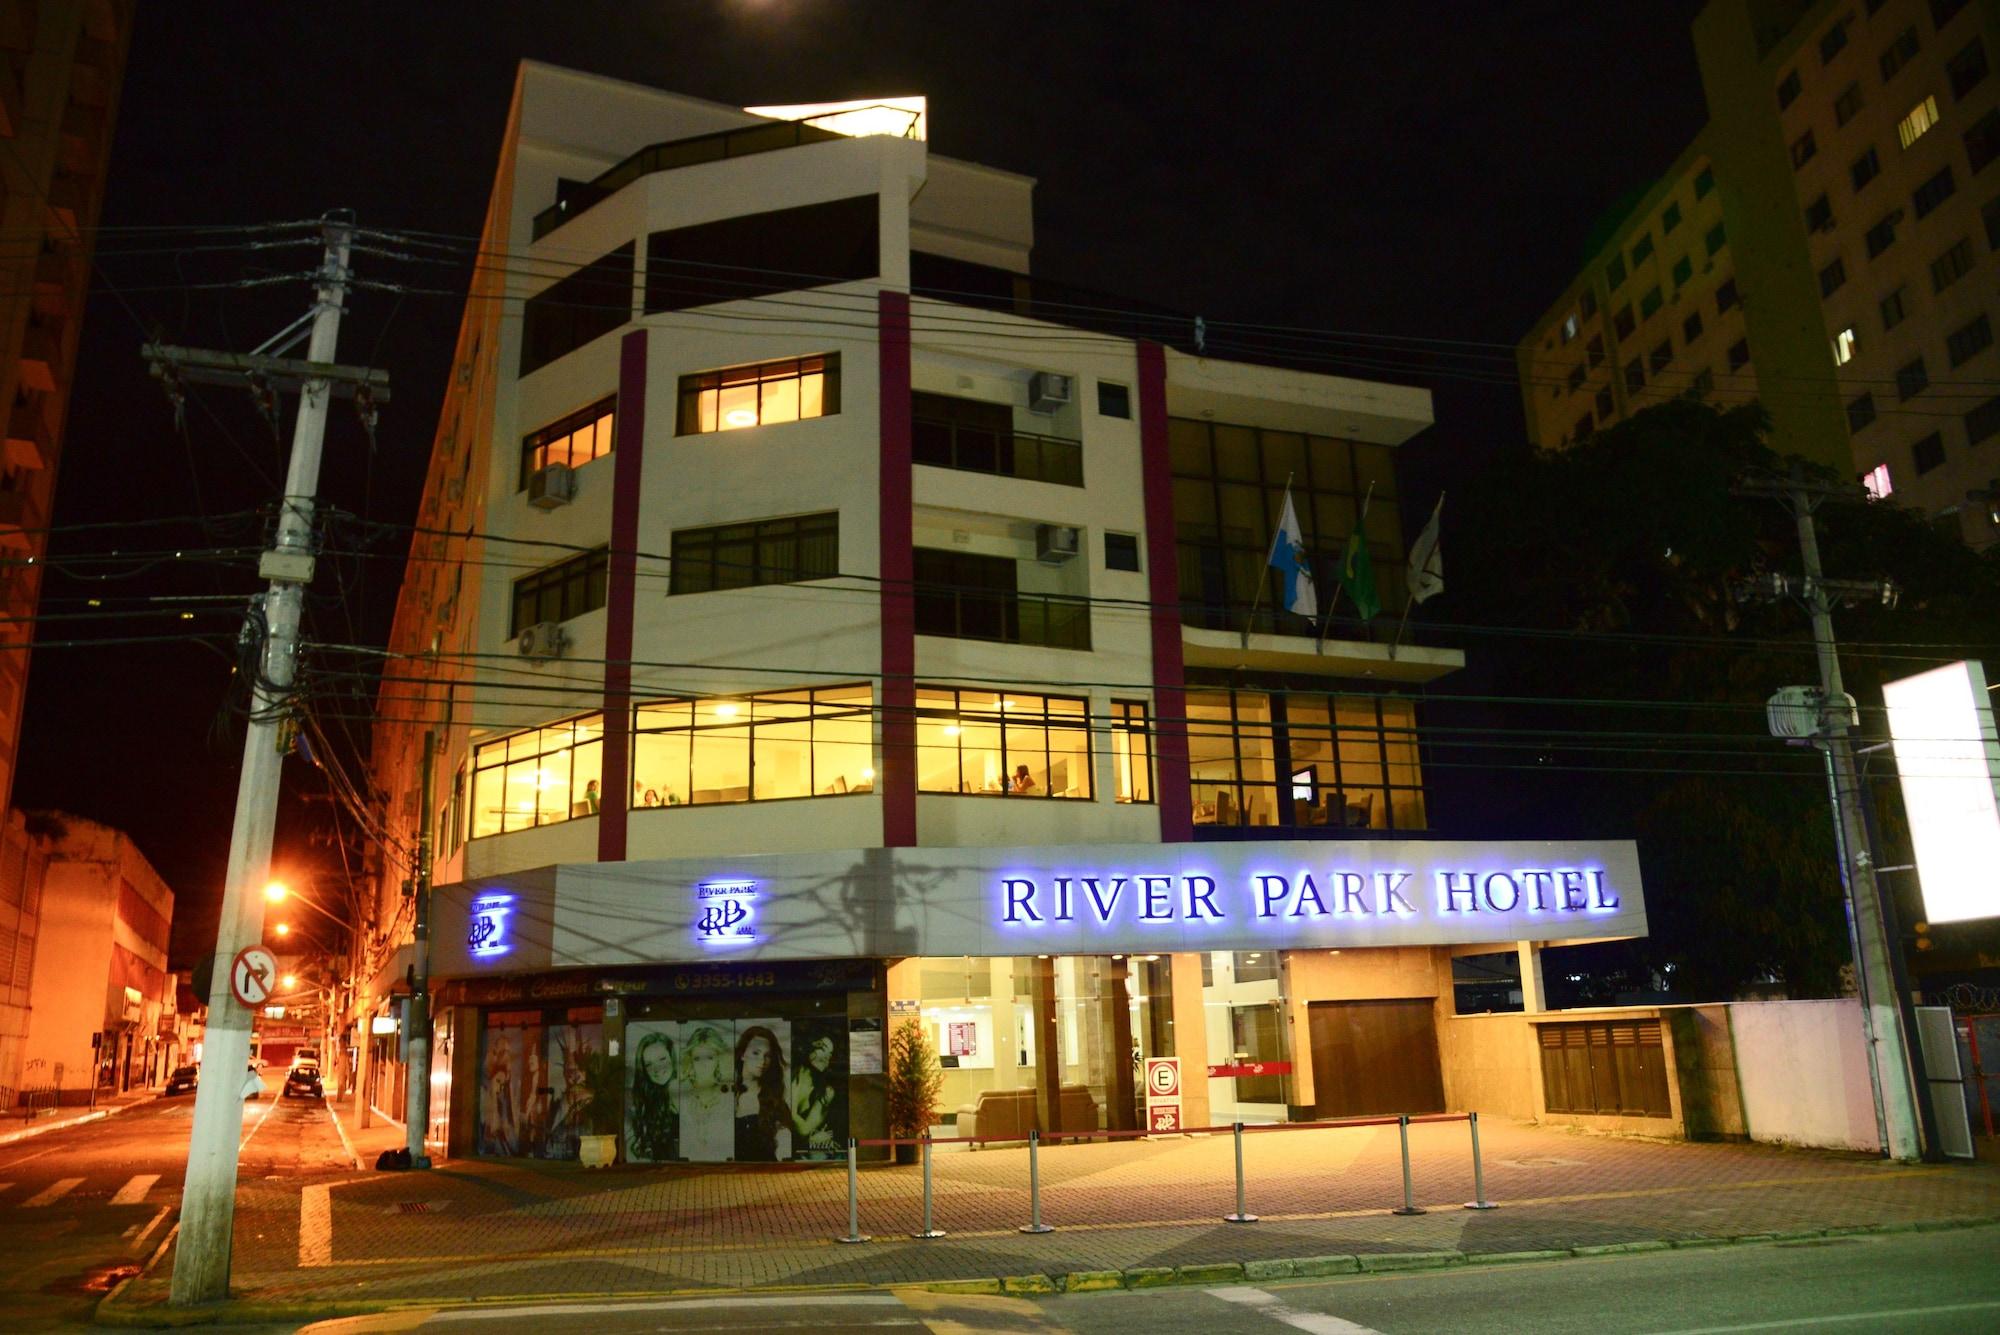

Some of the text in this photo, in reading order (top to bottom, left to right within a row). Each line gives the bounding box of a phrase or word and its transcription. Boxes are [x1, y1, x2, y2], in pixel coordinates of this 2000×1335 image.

[699, 885, 756, 896] RIVER PARK
[1001, 871, 1619, 922] RIVER PARK HOTEL
[1158, 1070, 1169, 1086] E
